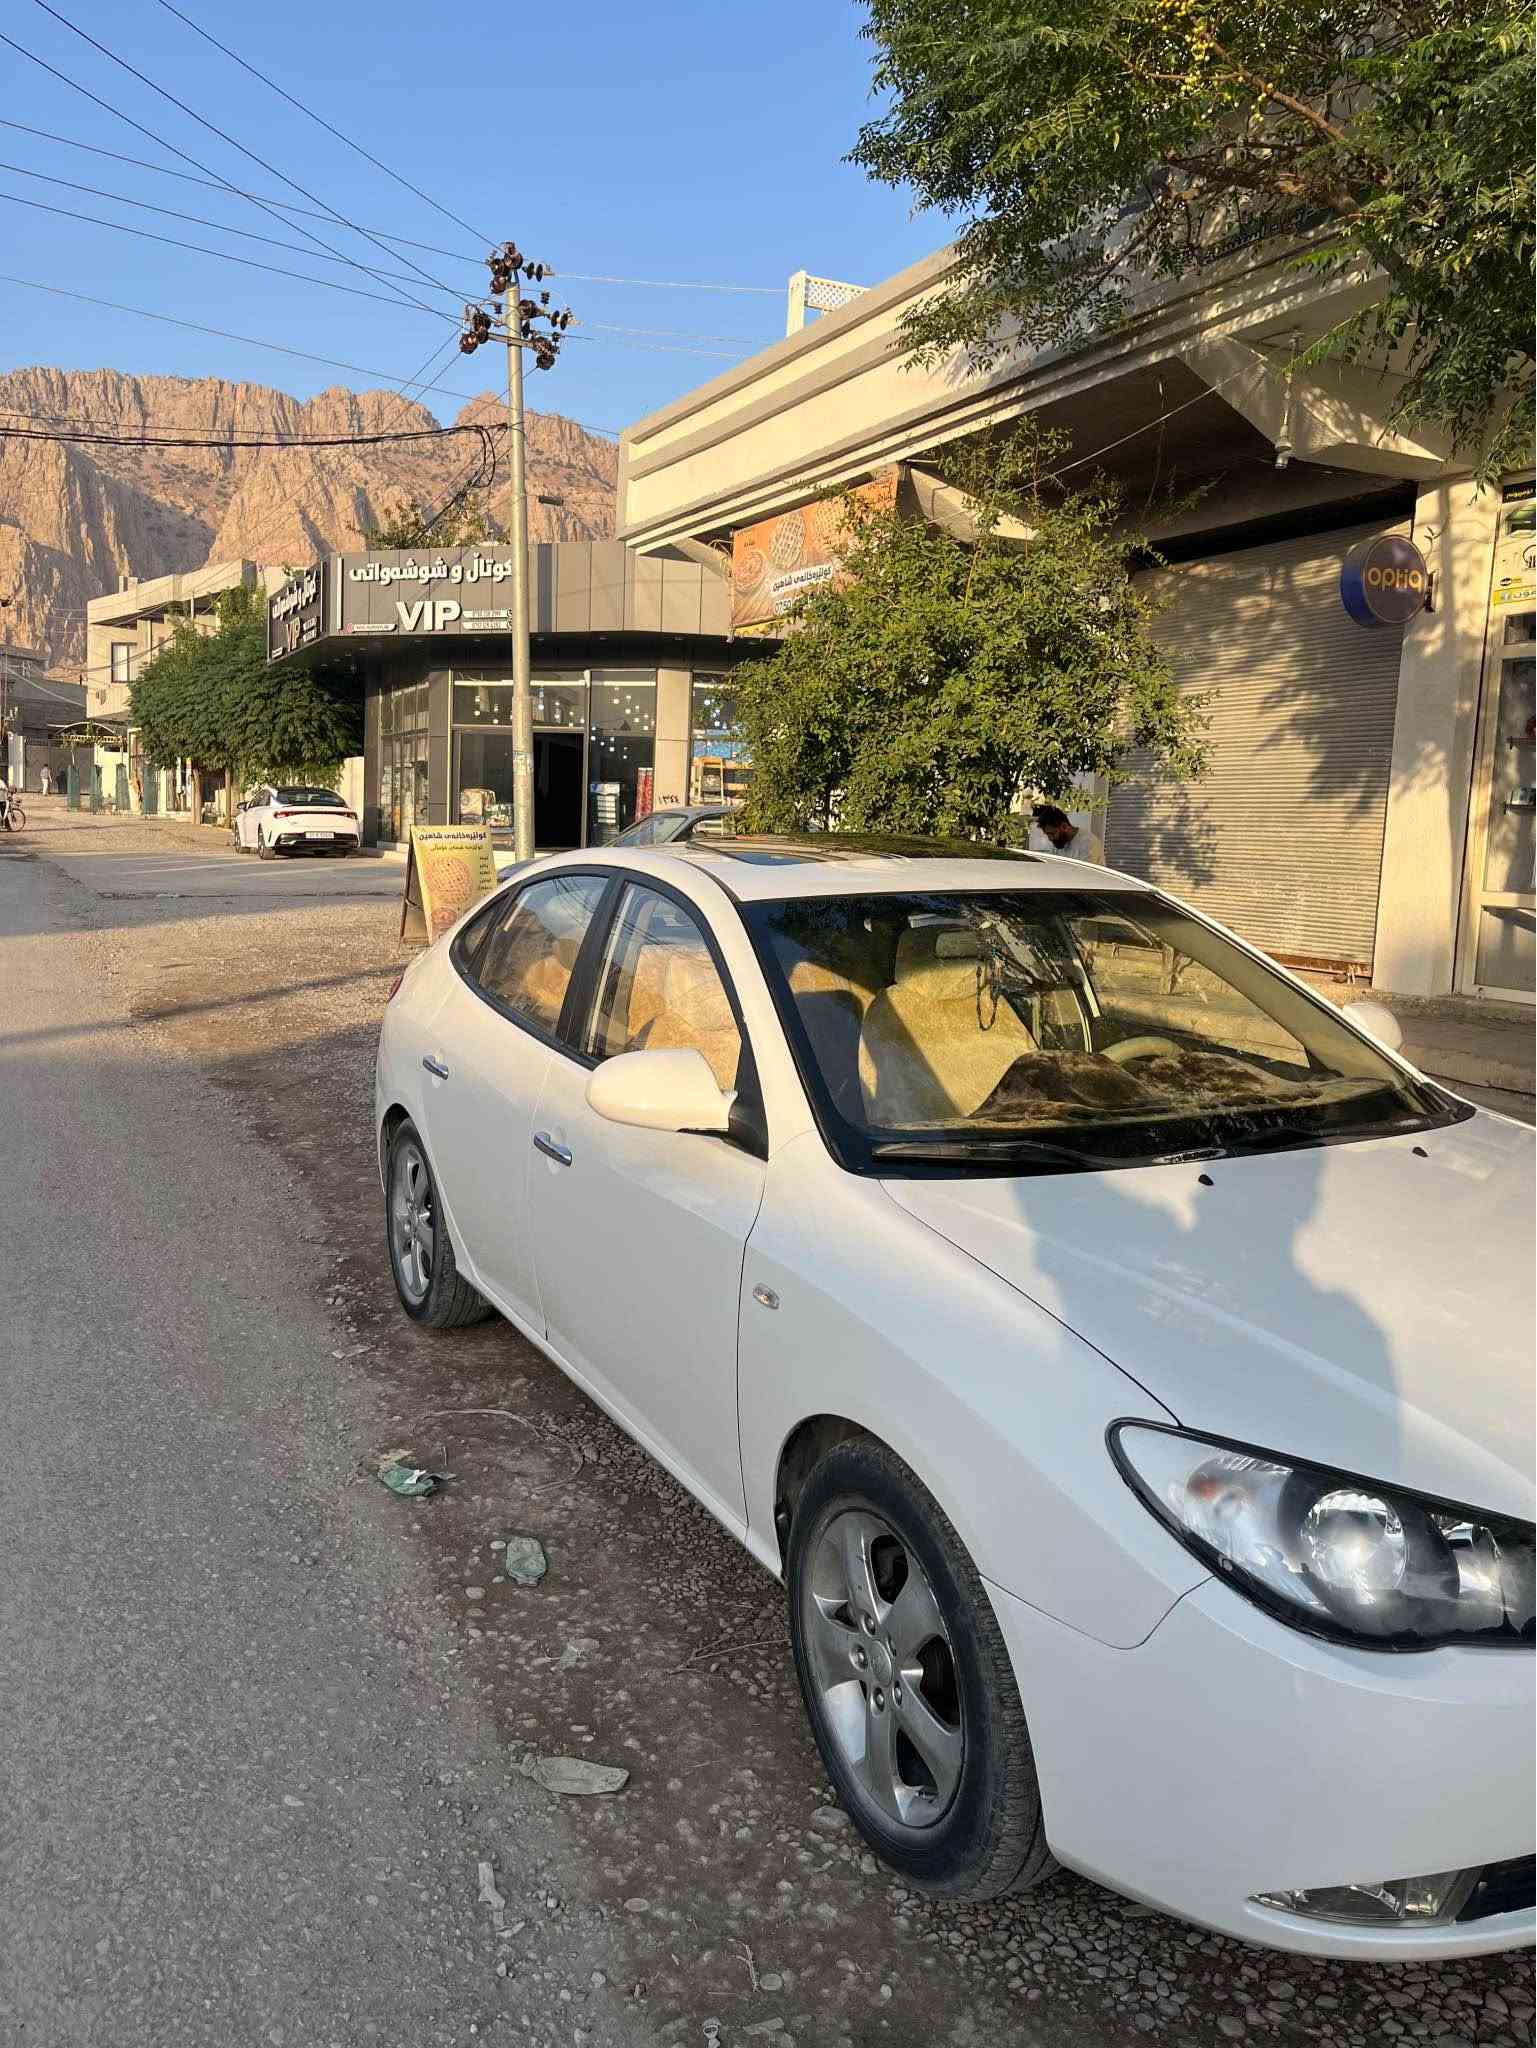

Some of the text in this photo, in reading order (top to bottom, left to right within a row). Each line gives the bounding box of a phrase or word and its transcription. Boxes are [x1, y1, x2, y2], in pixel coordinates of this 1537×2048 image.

[450, 563, 463, 584] و
[396, 600, 460, 631] VIP
[286, 617, 300, 652] VIP
